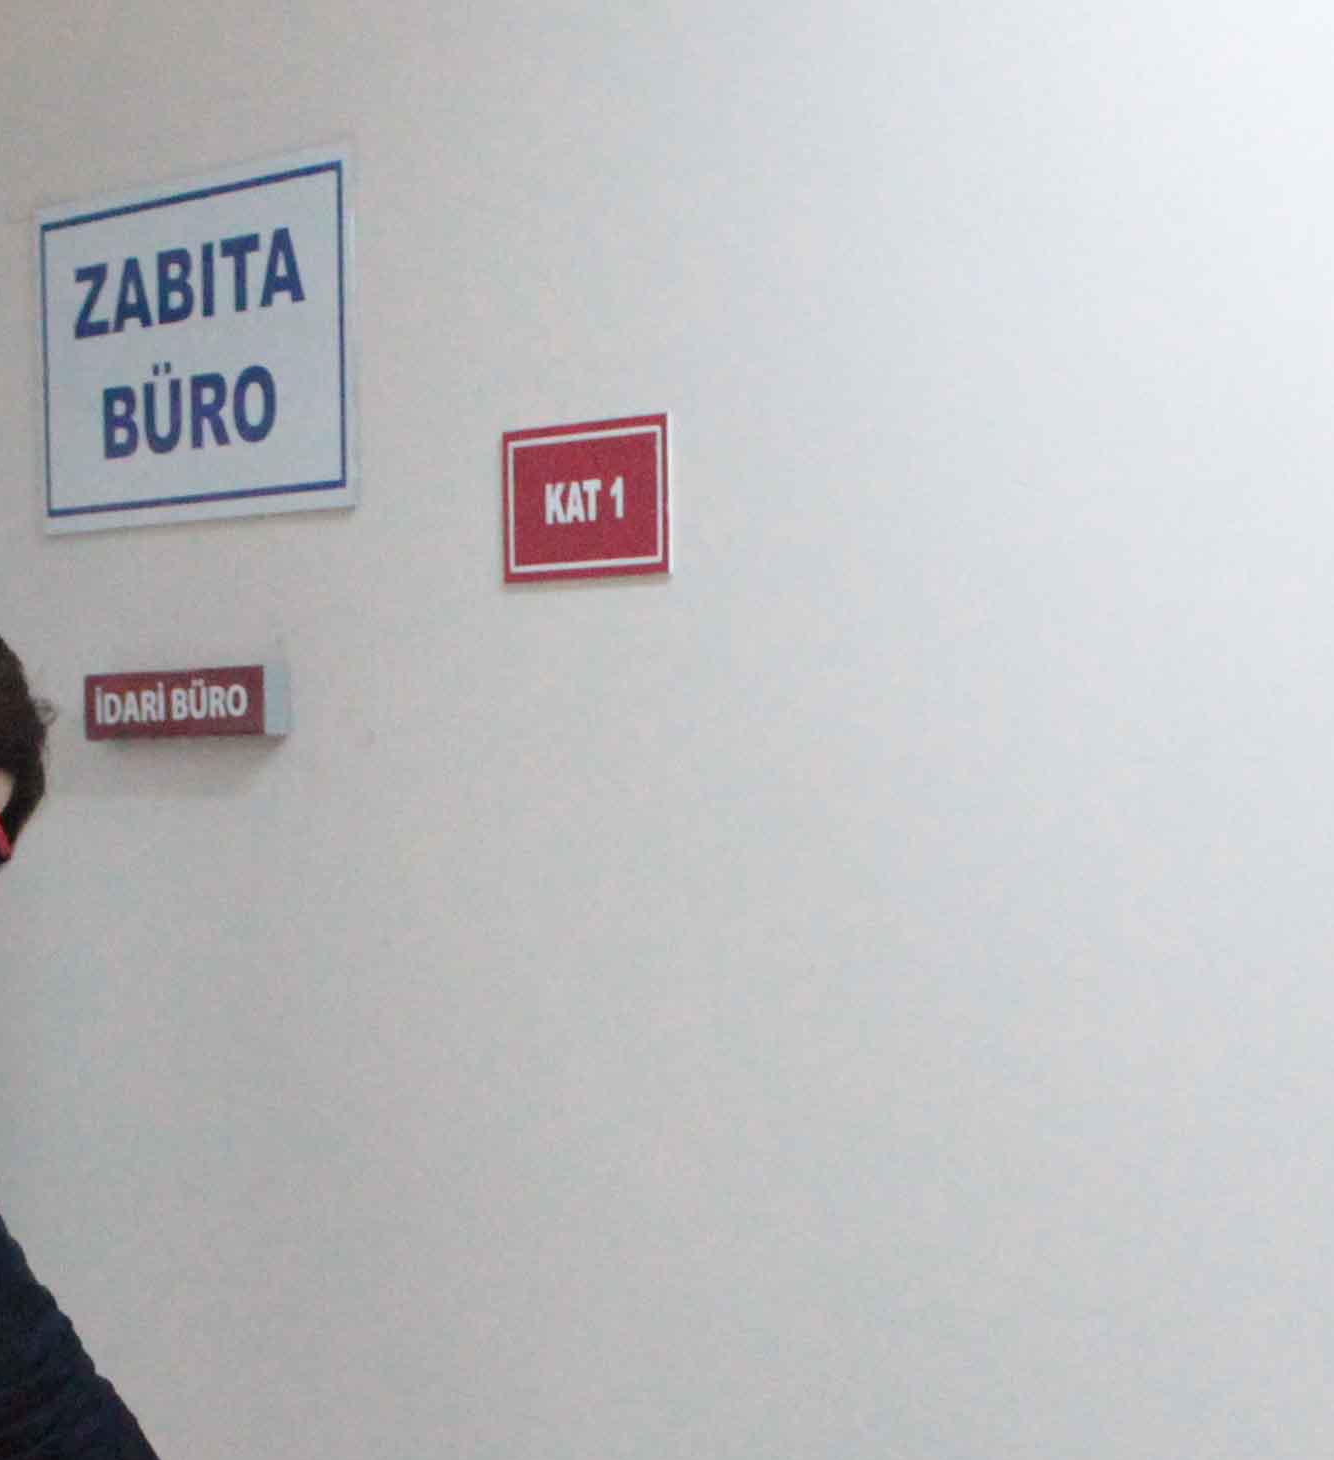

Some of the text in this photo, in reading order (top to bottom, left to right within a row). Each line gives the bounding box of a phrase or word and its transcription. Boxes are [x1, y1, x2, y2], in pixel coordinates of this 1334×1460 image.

[74, 227, 306, 340] ZABITA
[102, 363, 277, 460] BÜRO
[544, 476, 626, 525] KAT 1
[94, 678, 248, 725] İDARİ BÜRO
